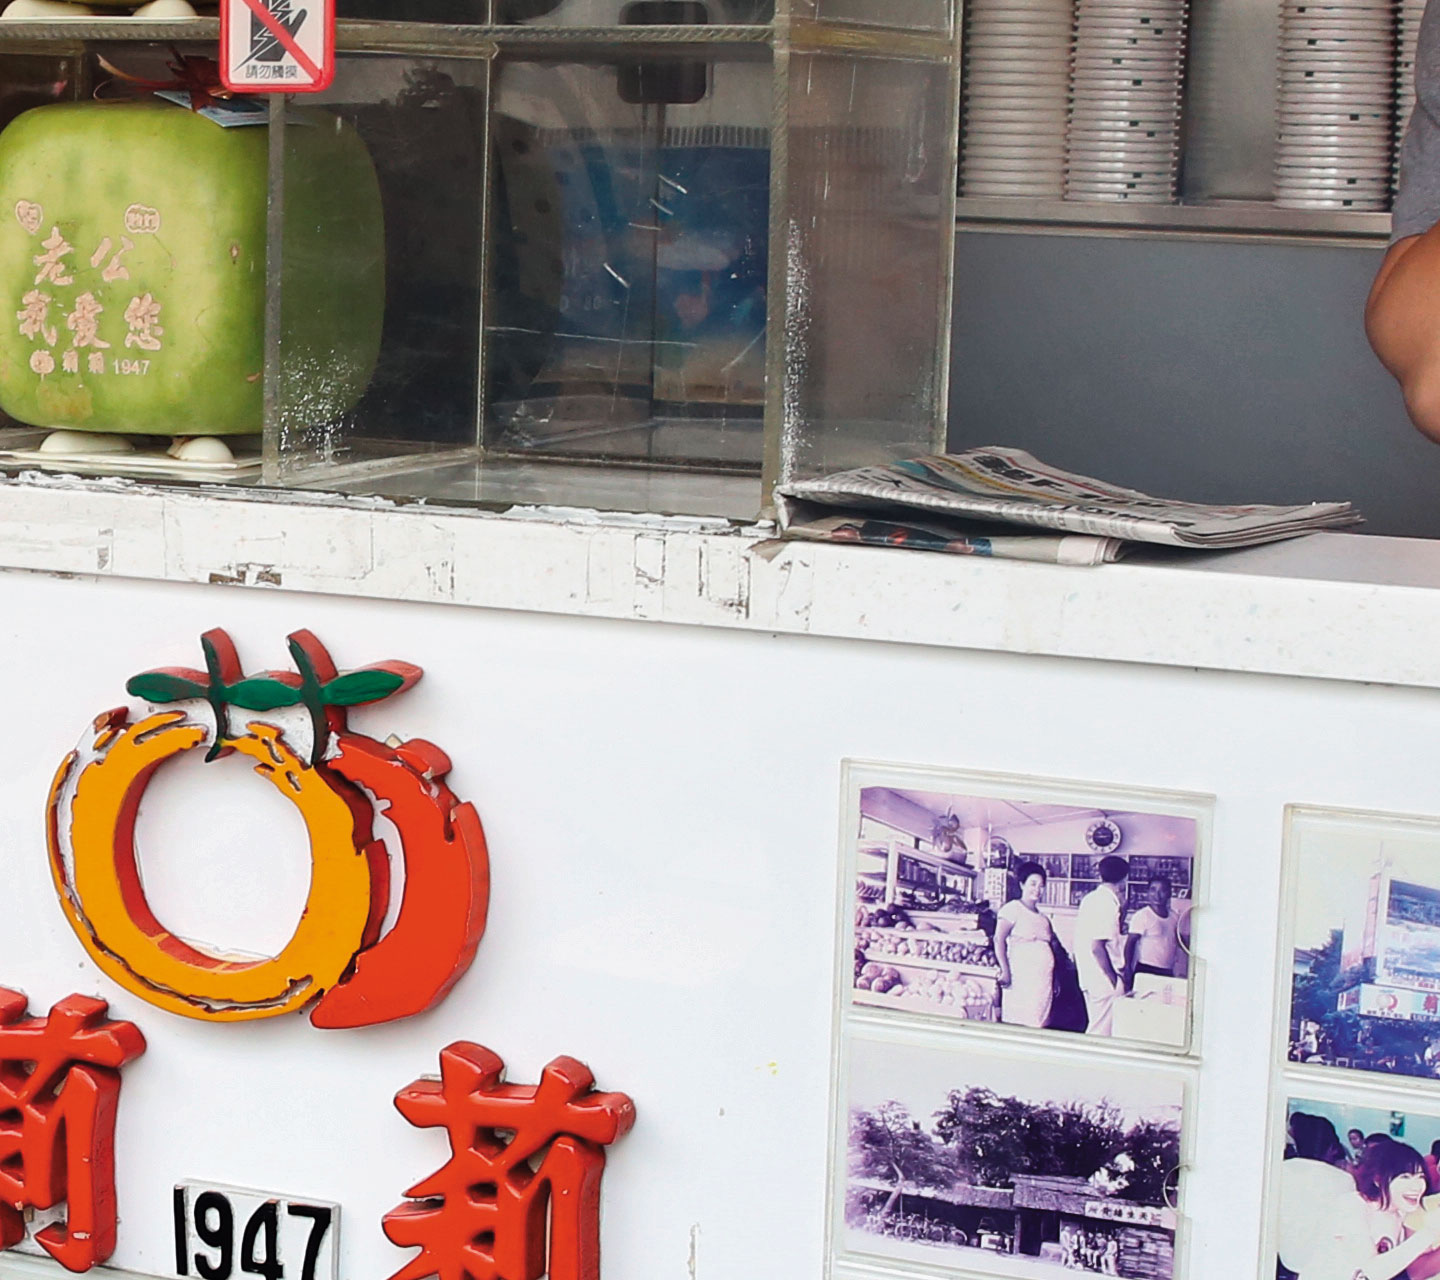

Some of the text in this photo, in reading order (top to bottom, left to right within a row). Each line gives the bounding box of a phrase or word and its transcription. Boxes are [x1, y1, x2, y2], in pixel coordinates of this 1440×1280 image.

[245, 65, 297, 79] 請勿觸摸
[33, 226, 135, 285] 老公
[16, 289, 164, 351] 我愛您
[112, 359, 151, 376] 1947
